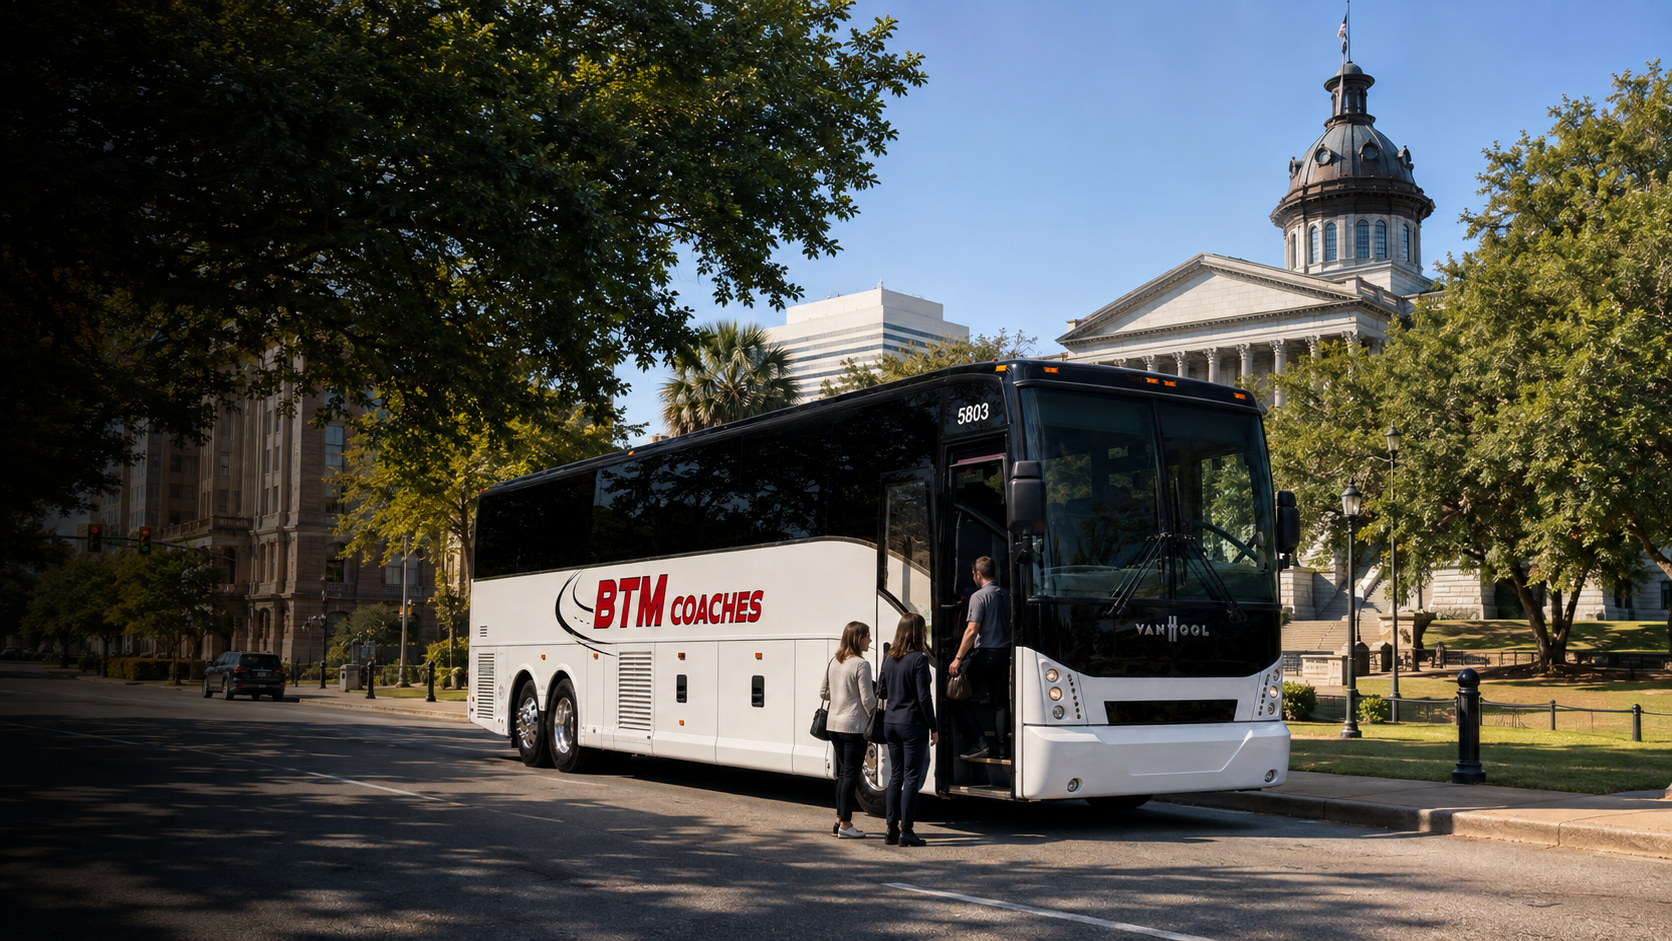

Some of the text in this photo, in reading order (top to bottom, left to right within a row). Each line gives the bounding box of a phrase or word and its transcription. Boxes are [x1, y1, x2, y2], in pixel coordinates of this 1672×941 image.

[957, 402, 989, 425] 5803
[593, 573, 764, 629] BTM COACHES
